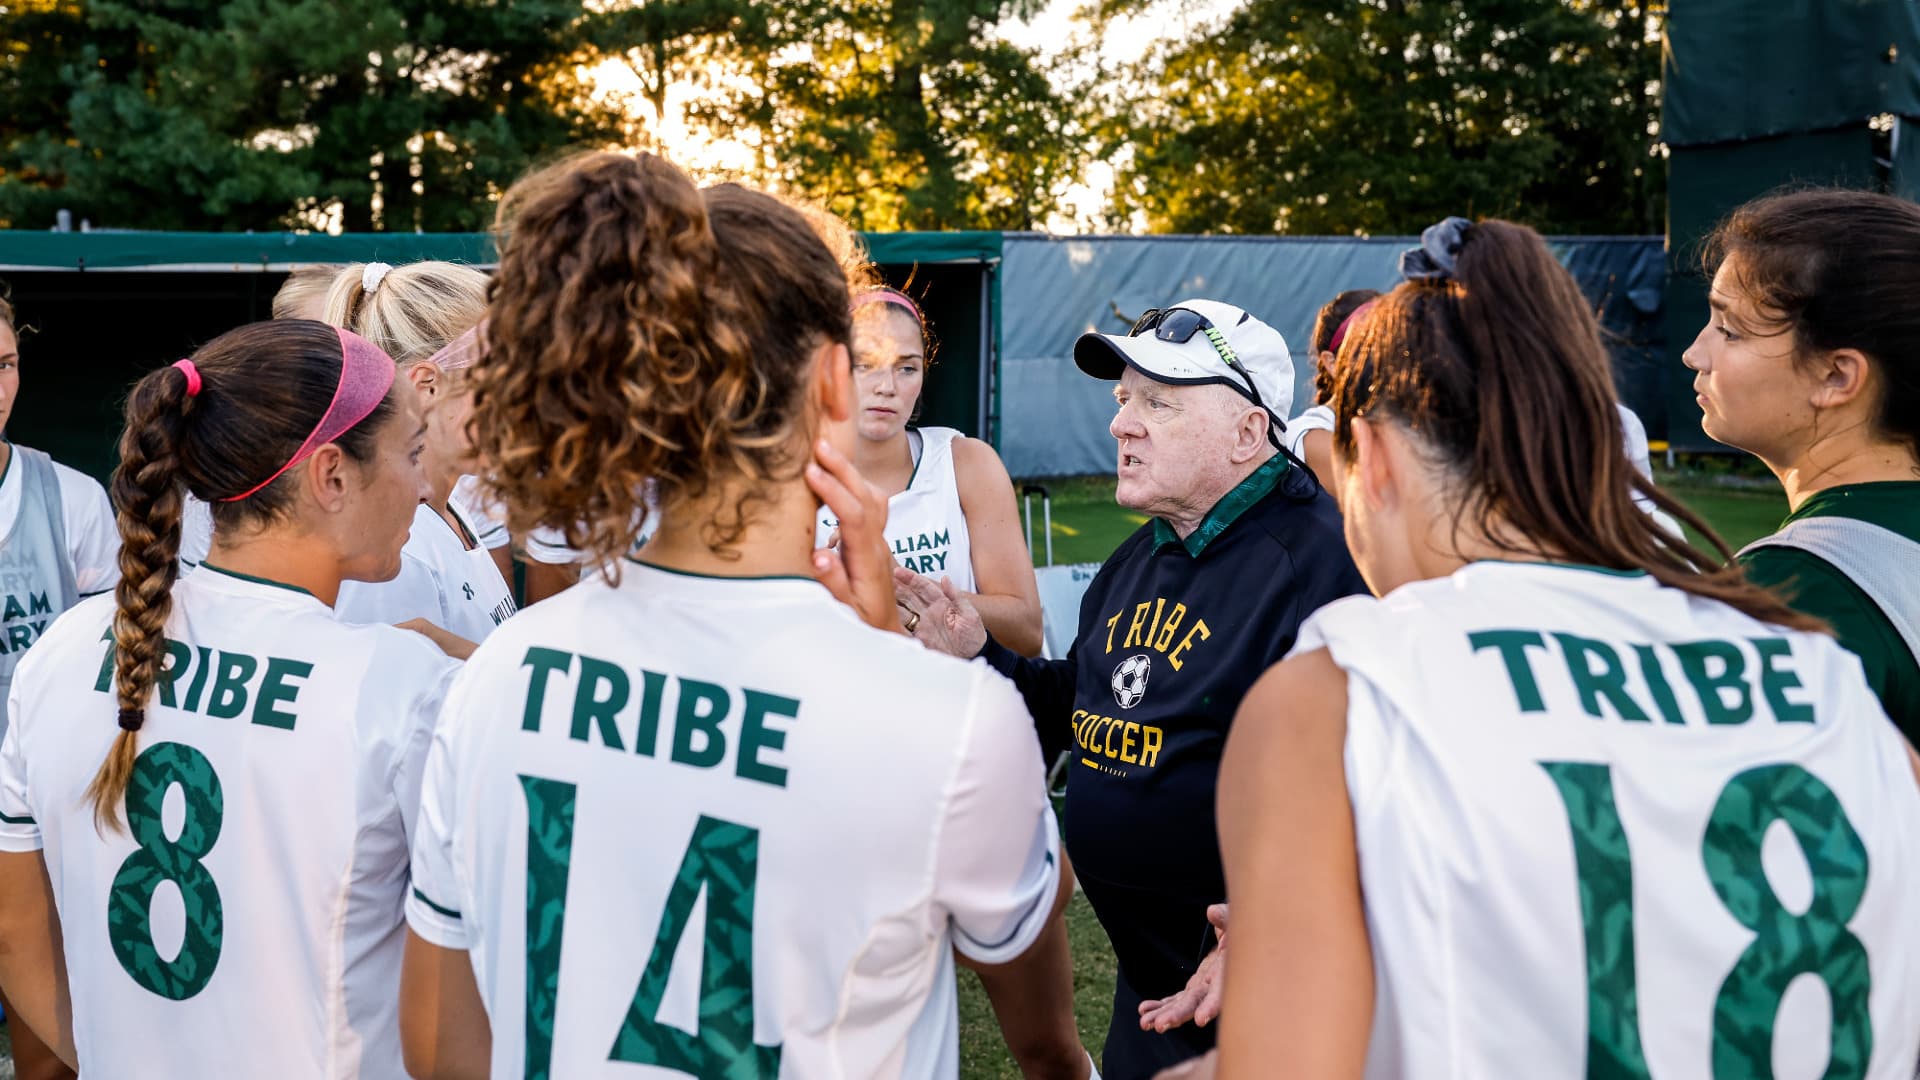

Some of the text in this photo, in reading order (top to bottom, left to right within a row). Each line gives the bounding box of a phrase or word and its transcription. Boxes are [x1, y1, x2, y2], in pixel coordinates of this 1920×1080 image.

[892, 527, 951, 554] LIAM
[903, 550, 948, 574] ARY
[1105, 597, 1211, 672] TRIBE
[1466, 629, 1816, 726] TRIBE
[520, 645, 801, 789] TRIBE
[1071, 709, 1163, 768] SOCCER
[108, 741, 224, 1001] 8
[1536, 759, 1874, 1080] 18
[517, 774, 783, 1080] 14
